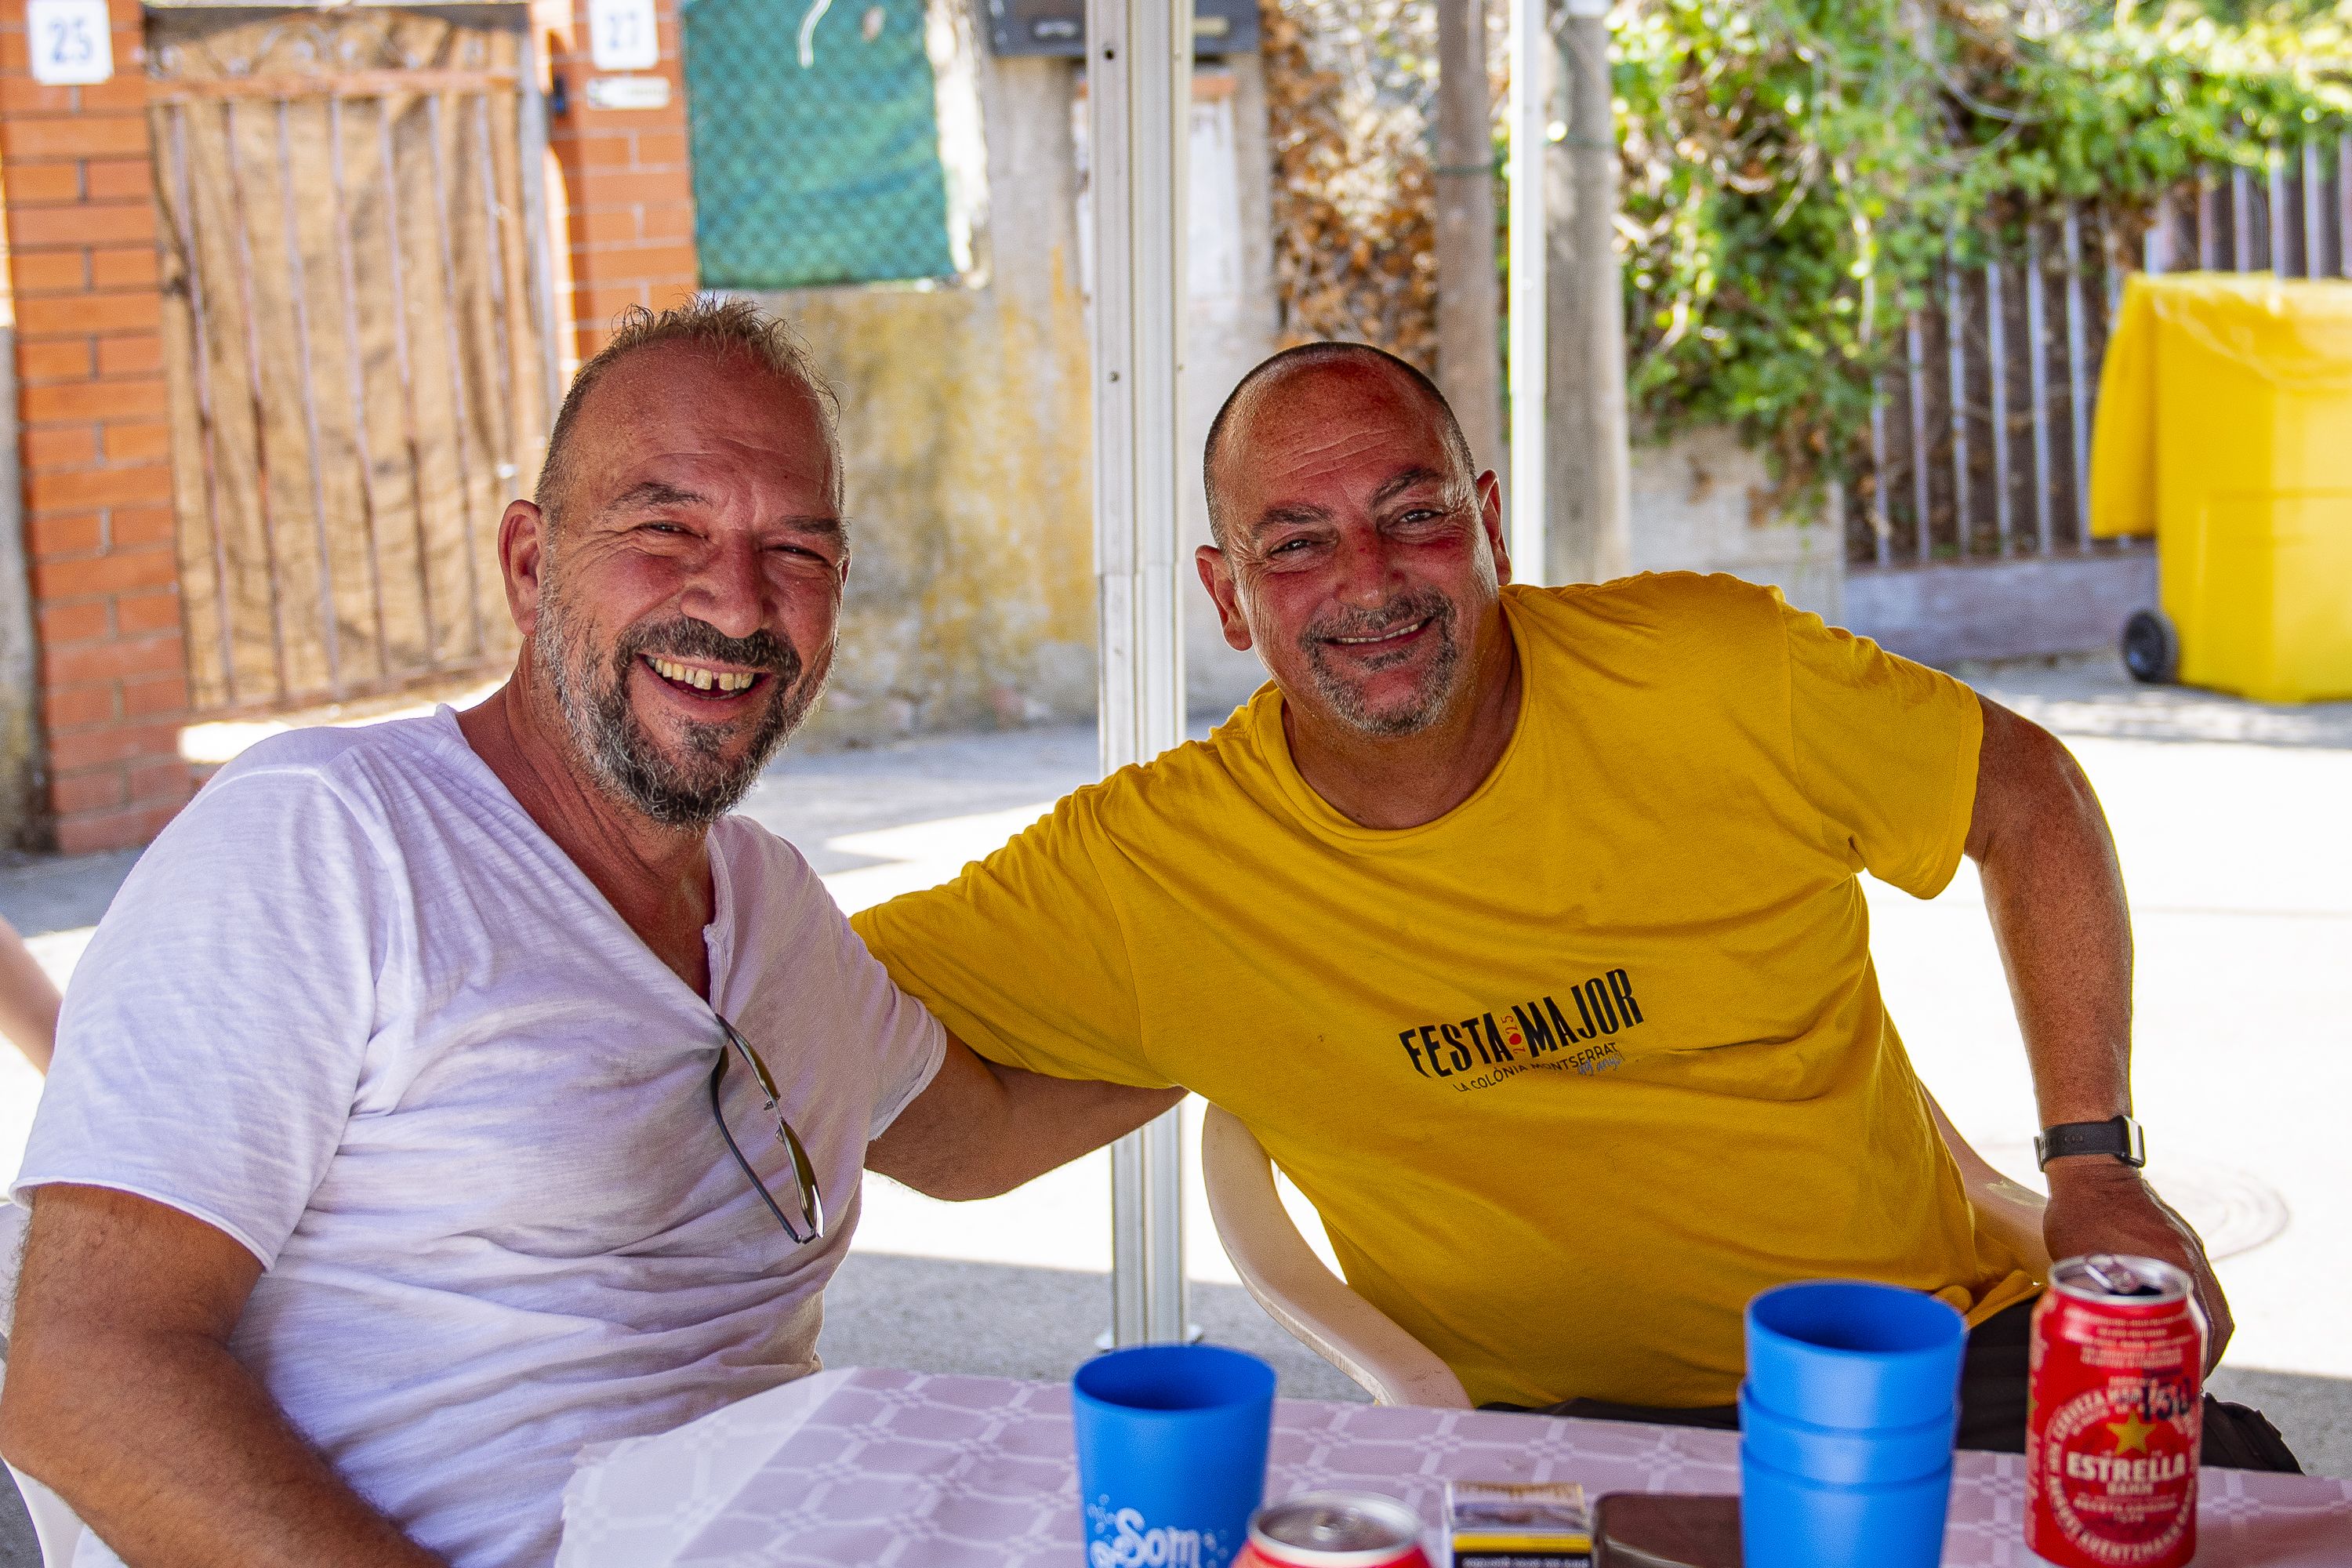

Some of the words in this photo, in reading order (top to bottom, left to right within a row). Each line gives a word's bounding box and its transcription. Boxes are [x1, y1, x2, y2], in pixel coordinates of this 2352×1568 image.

[49, 17, 93, 64] 25
[608, 9, 640, 50] 27
[1399, 1011, 1515, 1079] FESTA
[1511, 967, 1645, 1059] MAJOR
[1452, 1081, 1472, 1093] LA
[1470, 1063, 1529, 1090] COLÒNIA
[1530, 1041, 1618, 1072] MONTSERRAT
[2066, 1450, 2187, 1483] ESTRELLA
[1091, 1507, 1201, 1568] Som
